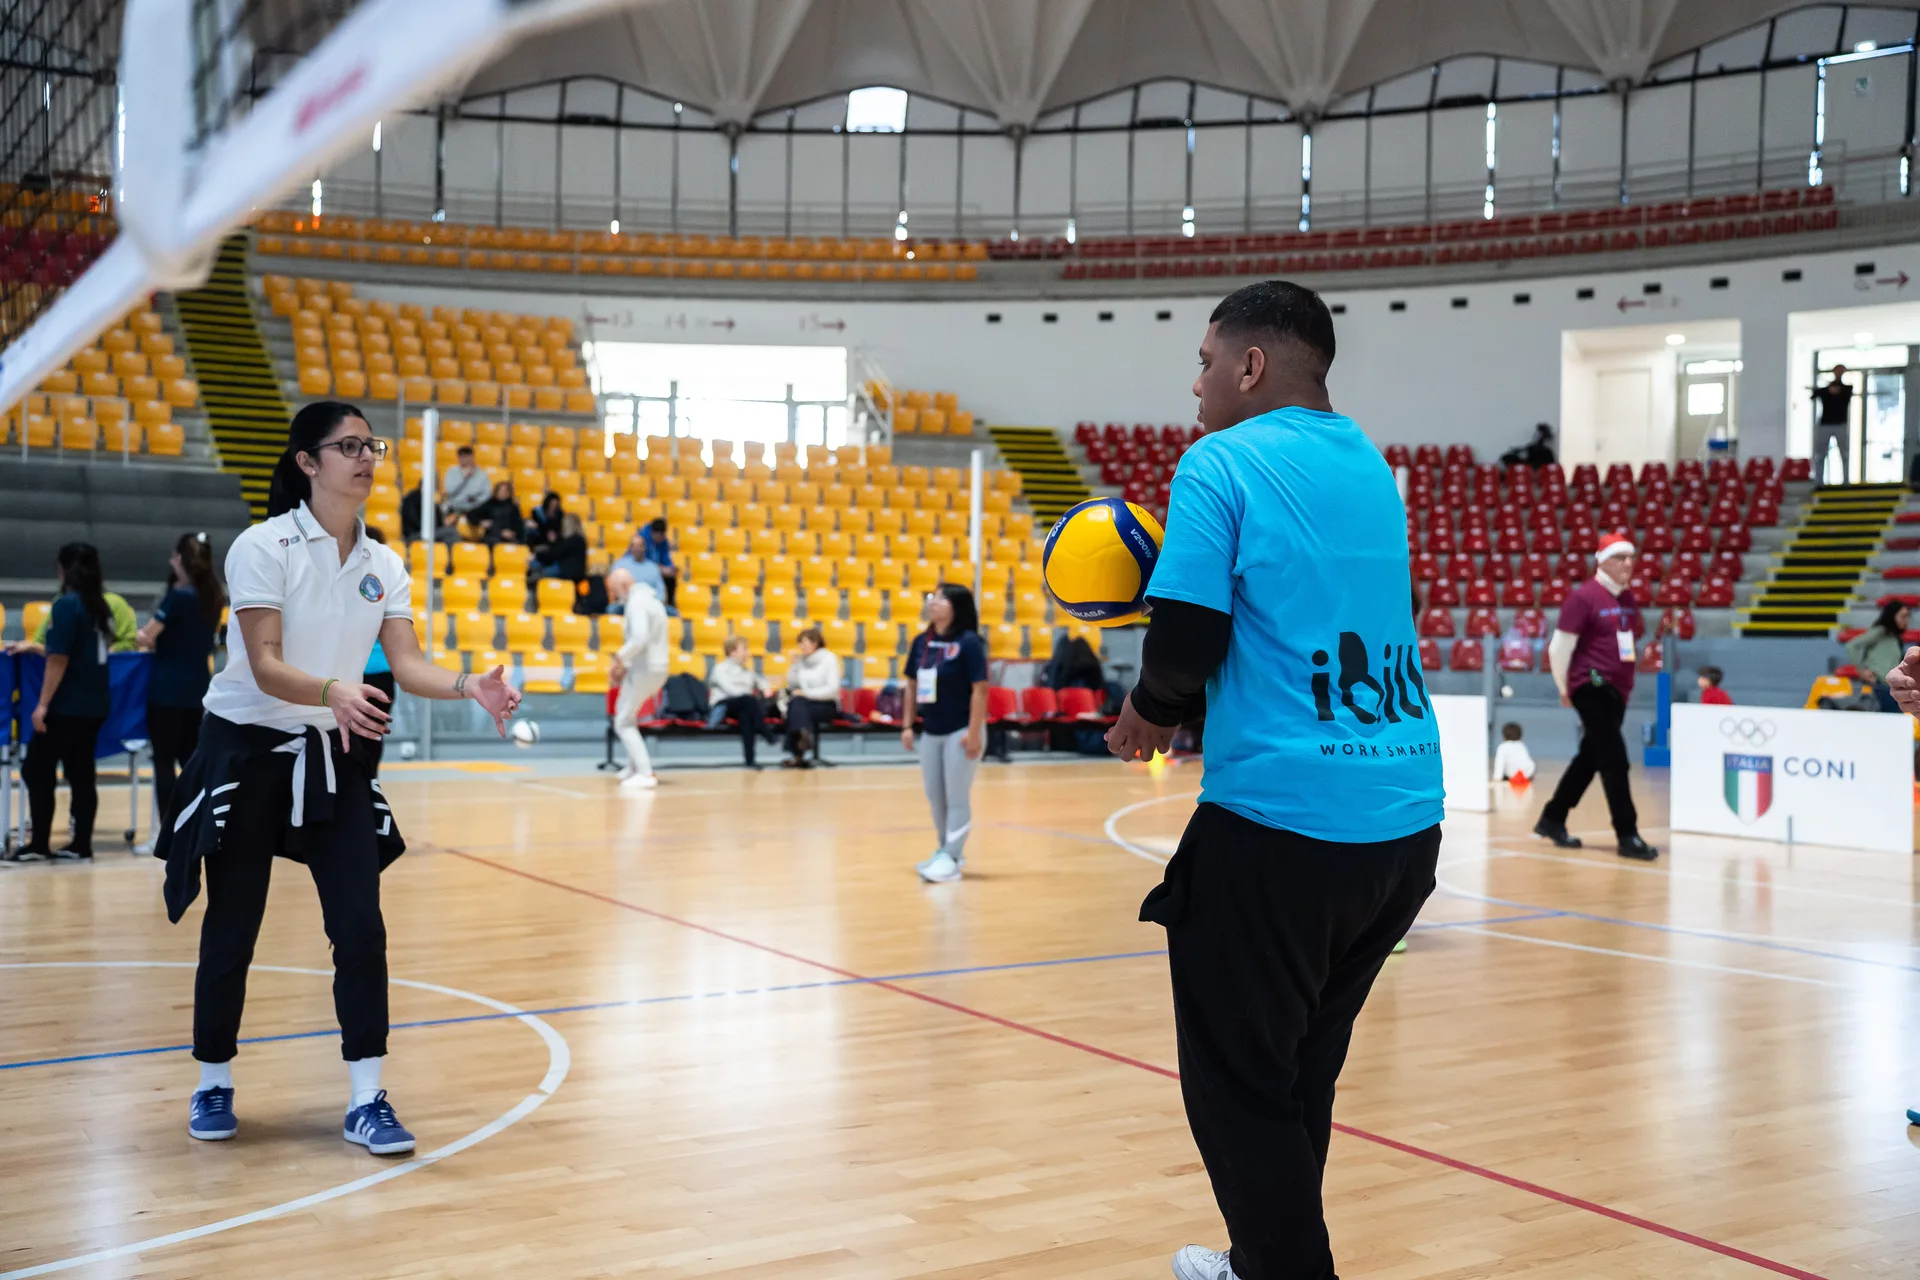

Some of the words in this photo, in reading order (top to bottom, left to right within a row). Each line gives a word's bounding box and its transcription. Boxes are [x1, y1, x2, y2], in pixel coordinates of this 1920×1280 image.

[1130, 528, 1153, 559] V200W
[1319, 743, 1380, 757] WORK
[1386, 741, 1441, 757] SMARTE
[1726, 754, 1770, 769] ITALIA
[1783, 756, 1855, 781] CONI
